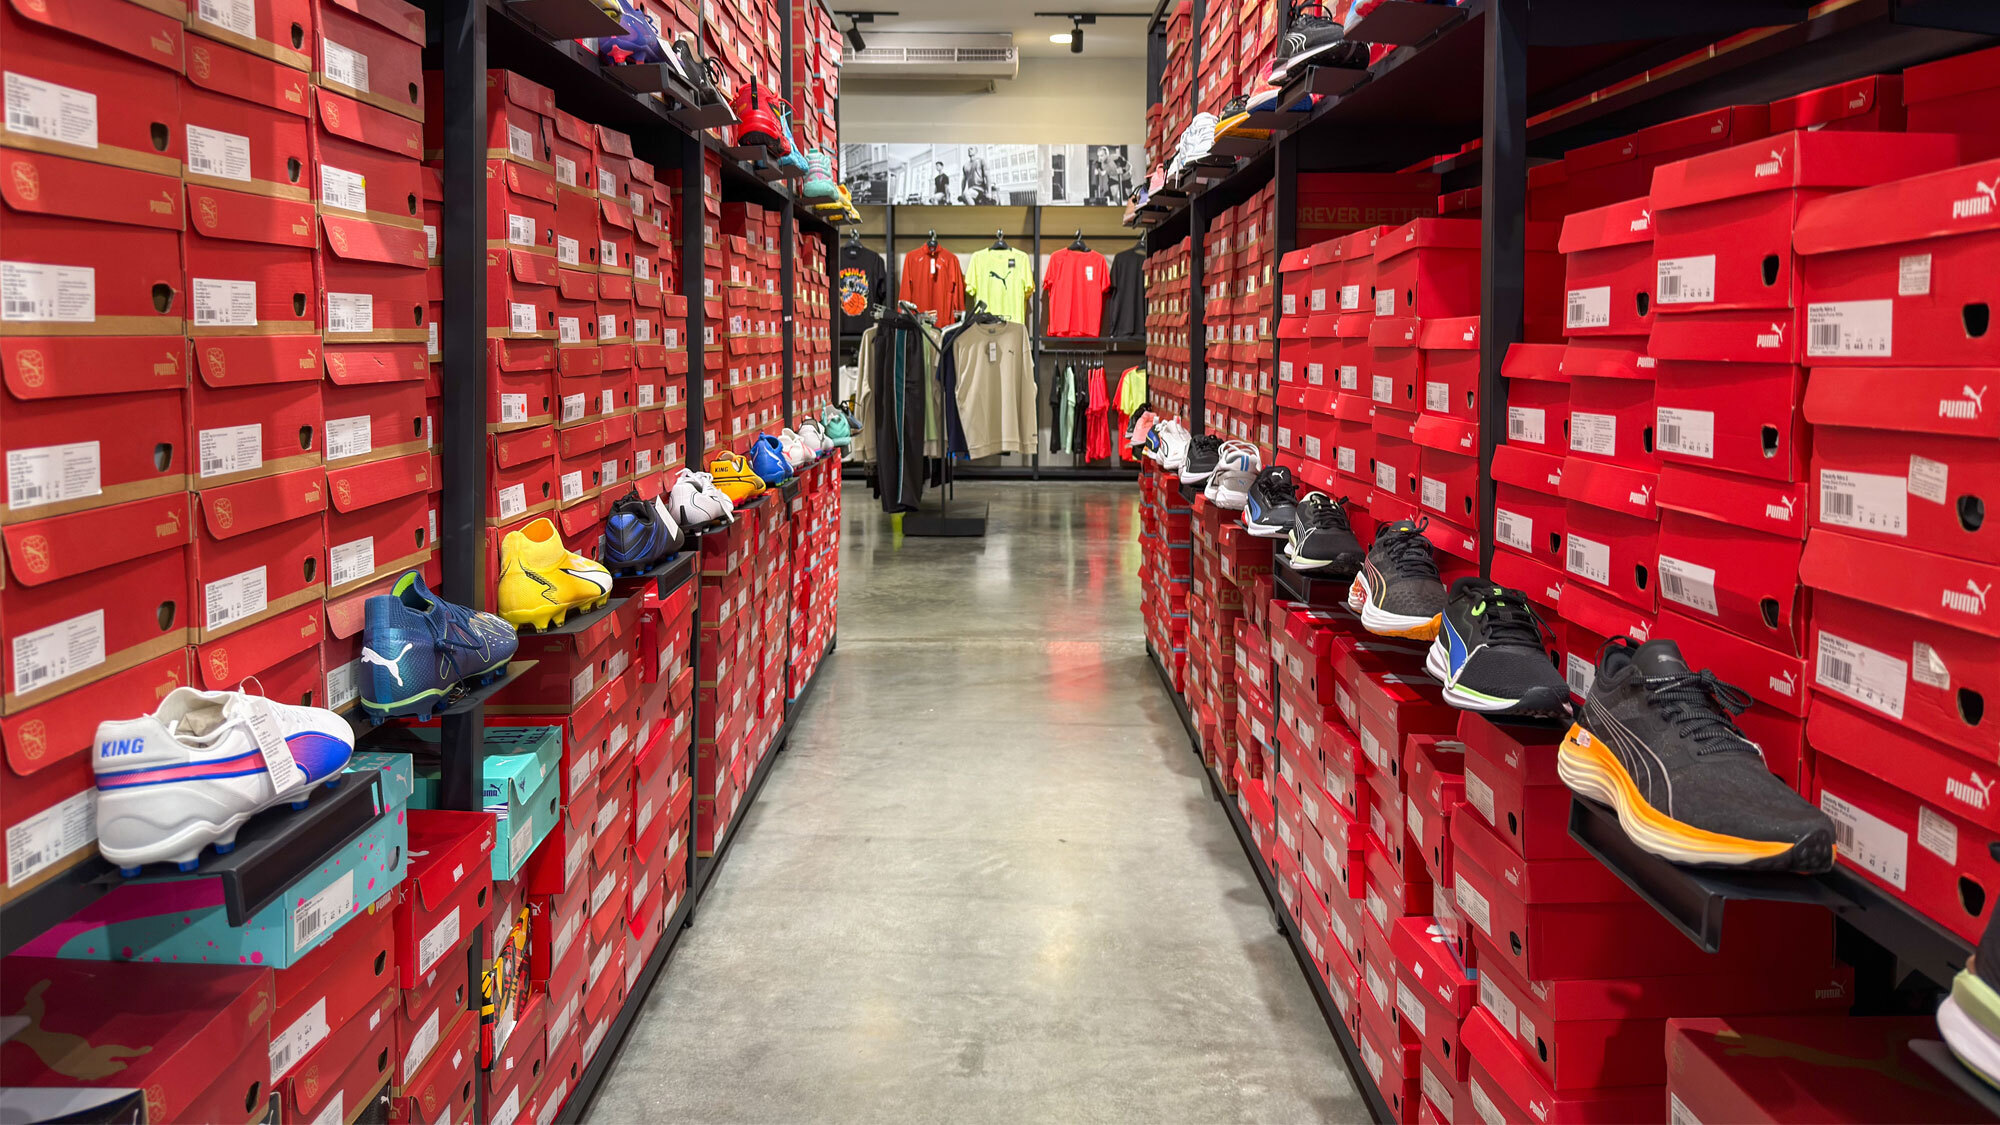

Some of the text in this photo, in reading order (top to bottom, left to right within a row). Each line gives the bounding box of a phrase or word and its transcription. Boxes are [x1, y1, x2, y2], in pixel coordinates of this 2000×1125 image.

[1755, 161, 1780, 178] PUMA
[1953, 196, 1990, 219] PUMA
[1756, 334, 1780, 348] PUMA
[1939, 399, 1976, 419] PUMA
[1766, 504, 1789, 521] PUMA
[1942, 589, 1980, 615] PUMA
[1769, 675, 1792, 697] PUMA
[101, 737, 145, 758] KING
[1946, 777, 1984, 809] PUMA
